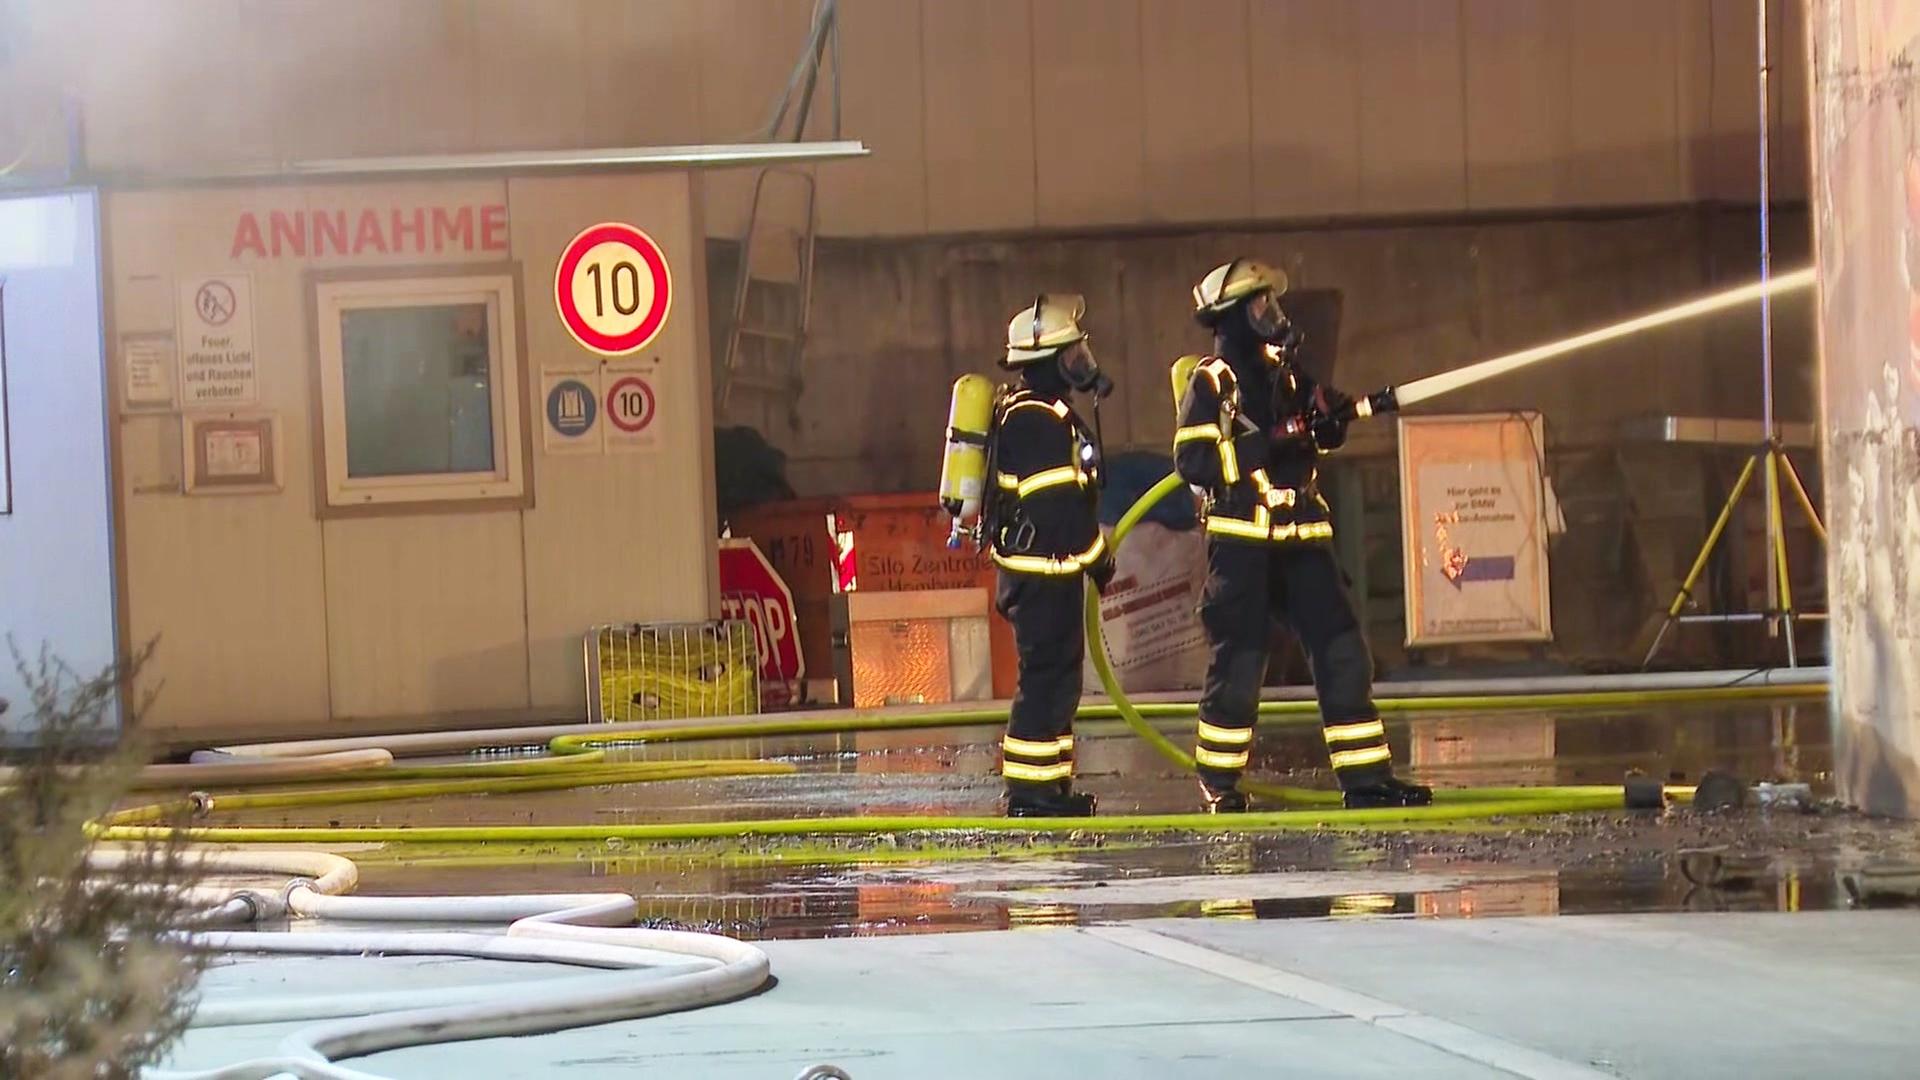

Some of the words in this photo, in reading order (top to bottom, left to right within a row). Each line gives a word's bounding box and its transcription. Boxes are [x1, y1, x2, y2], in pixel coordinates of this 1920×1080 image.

[230, 204, 507, 259] ANNAHME
[587, 261, 640, 317] 10
[225, 350, 251, 363] Licht
[186, 369, 206, 382] und
[208, 368, 252, 381] Rauchen
[195, 383, 244, 398] verboten!
[620, 391, 643, 417] 10
[1446, 486, 1466, 497] Hier
[1467, 486, 1489, 498] geht
[1455, 501, 1469, 510] zur
[1471, 499, 1495, 509] BMW
[868, 555, 905, 576] Silo
